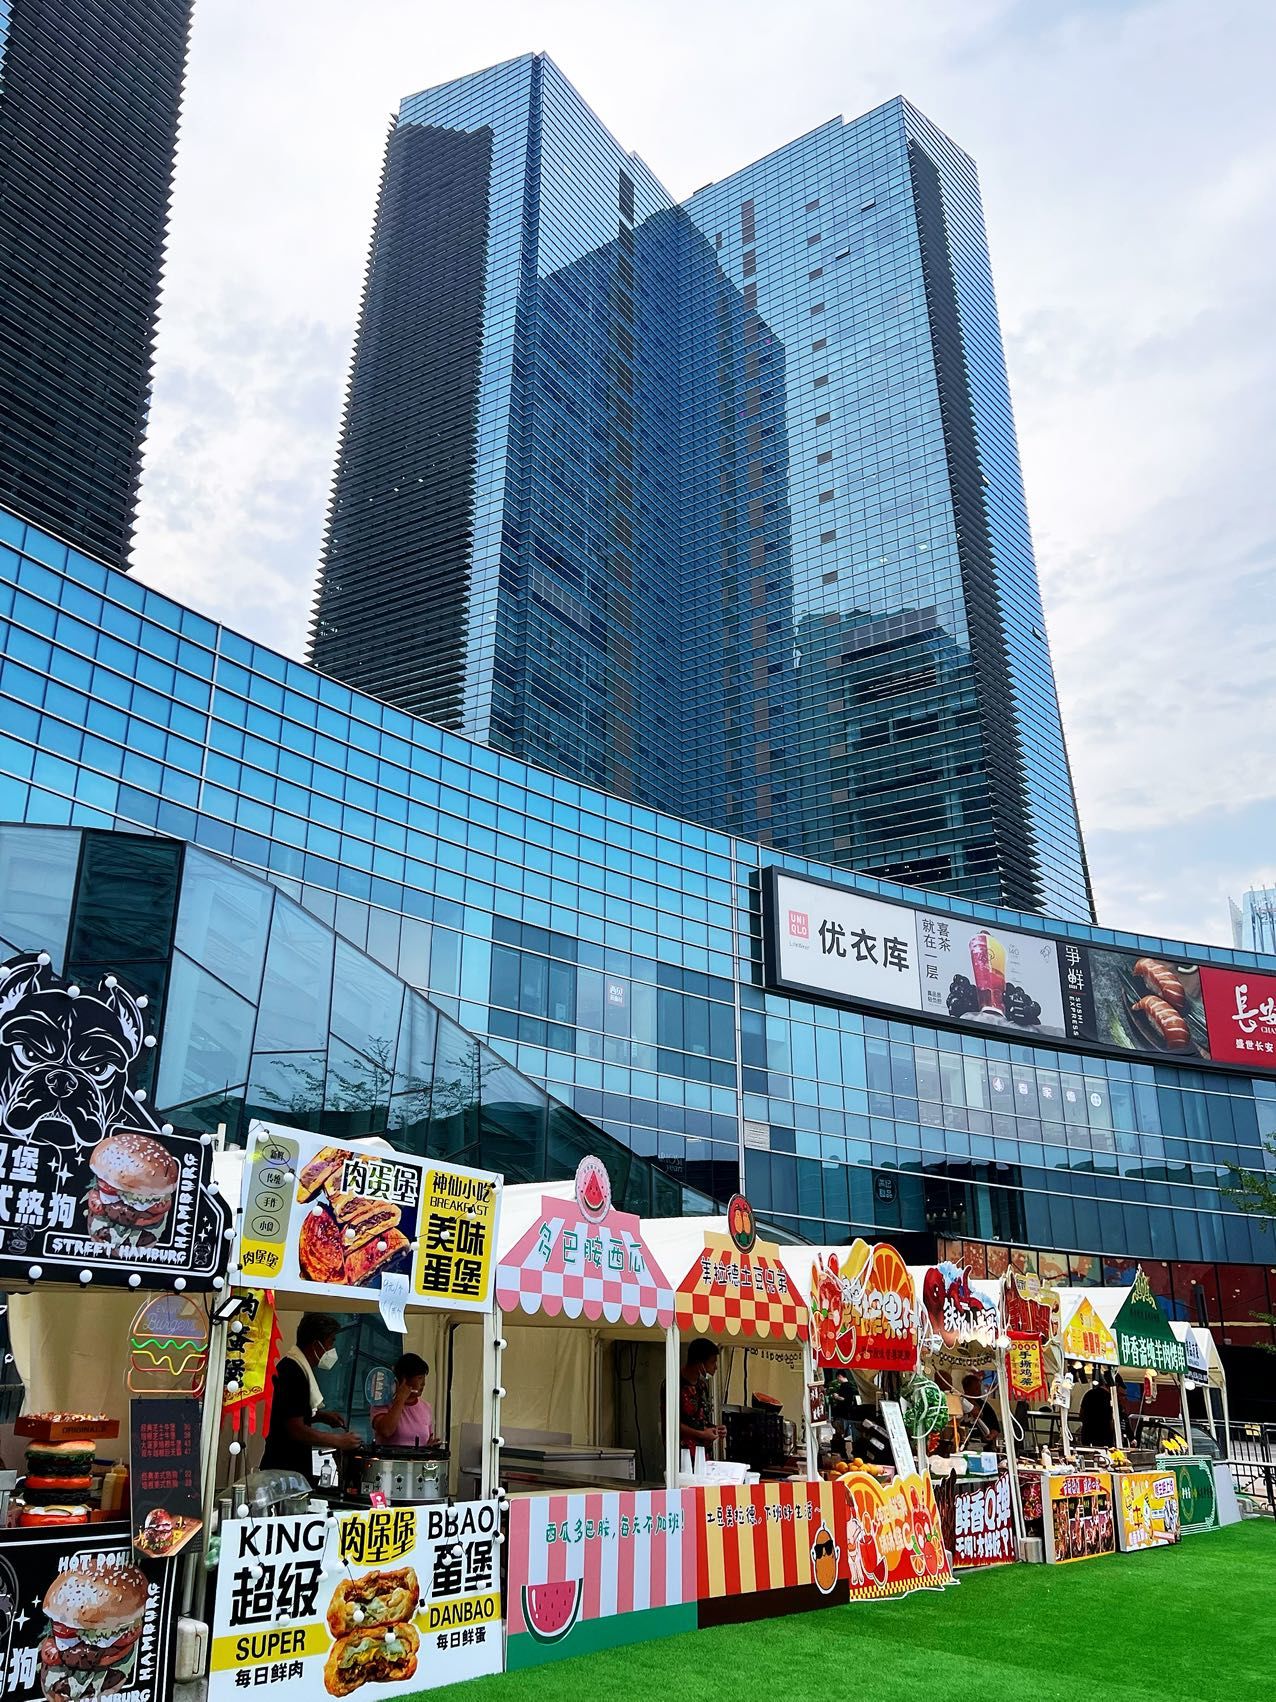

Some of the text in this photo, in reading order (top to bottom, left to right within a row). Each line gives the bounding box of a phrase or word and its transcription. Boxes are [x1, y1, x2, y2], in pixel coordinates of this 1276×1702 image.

[790, 914, 805, 925] UNI
[791, 924, 807, 936] QLO
[937, 922, 951, 952] 喜茶
[818, 919, 910, 973] 优衣库
[922, 918, 939, 981] 就在一层
[1068, 996, 1080, 1036] EXPRESS
[1075, 997, 1084, 1024] SUSHI
[0, 1142, 40, 1183] 堡
[174, 1152, 199, 1249] HAMBURG
[341, 1158, 419, 1207] 肉蛋堡
[432, 1171, 491, 1204] 神仙小吃
[429, 1197, 490, 1216] BREAKFAST
[52, 1237, 187, 1265] STREET HAMBURG
[425, 1212, 488, 1257] 美味
[538, 1221, 646, 1274] 多巴胺西瓜
[242, 1249, 279, 1270] 肉堡堡
[422, 1253, 483, 1296] 蛋堡
[701, 1256, 789, 1295] 美拉德土豆兄弟
[1018, 1350, 1034, 1386] 手撕鸡架
[428, 1505, 495, 1540] BBAO
[954, 1473, 1012, 1536] 鲜香Q弹
[238, 1520, 326, 1559] KING
[340, 1508, 418, 1564] 肉堡堡
[58, 1553, 91, 1574] HOT
[431, 1540, 494, 1598] 蛋堡
[229, 1559, 323, 1627] 超级
[139, 1583, 161, 1681] HAMBURG
[429, 1598, 495, 1628] DANBAO
[235, 1629, 306, 1661] SUPER
[436, 1626, 487, 1651] 每日鲜蛋
[234, 1660, 304, 1689] 每日鲜肉
